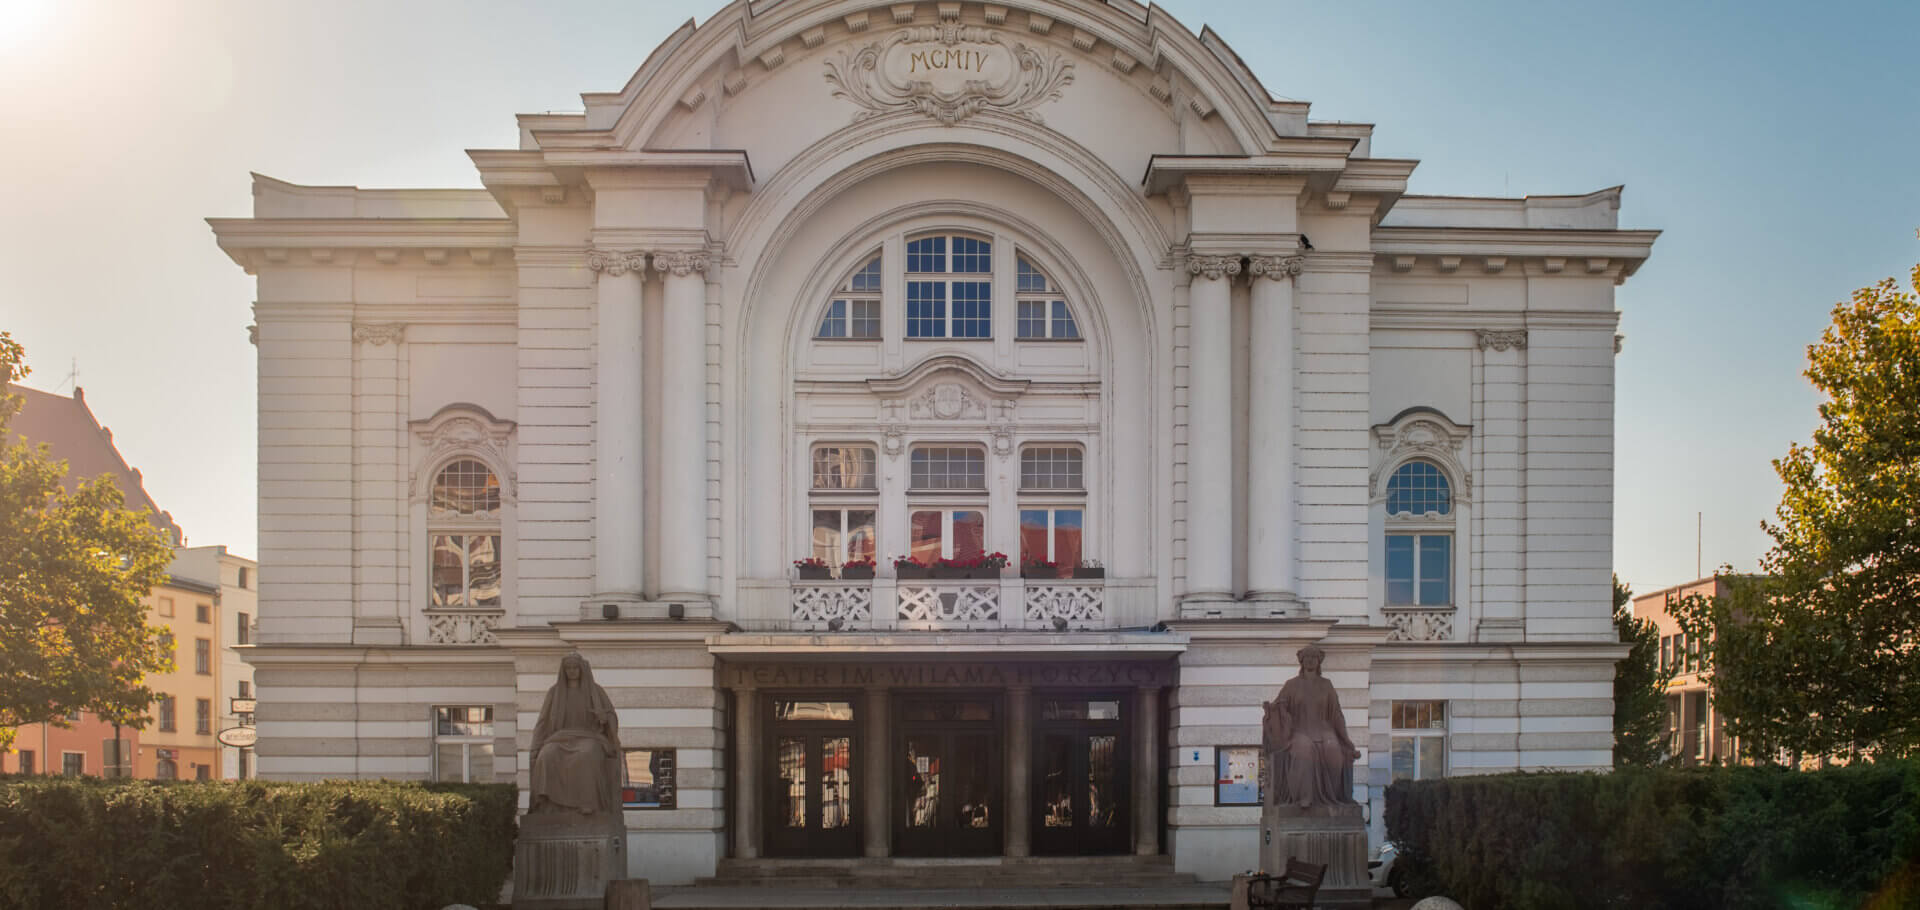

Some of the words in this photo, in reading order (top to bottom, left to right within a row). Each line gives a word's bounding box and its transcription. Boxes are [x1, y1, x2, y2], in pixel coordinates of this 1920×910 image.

[911, 49, 989, 72] MCMIV
[734, 666, 830, 685] TEATR
[888, 666, 1004, 685] WILAMA
[1016, 665, 1161, 685] HORZYCY
